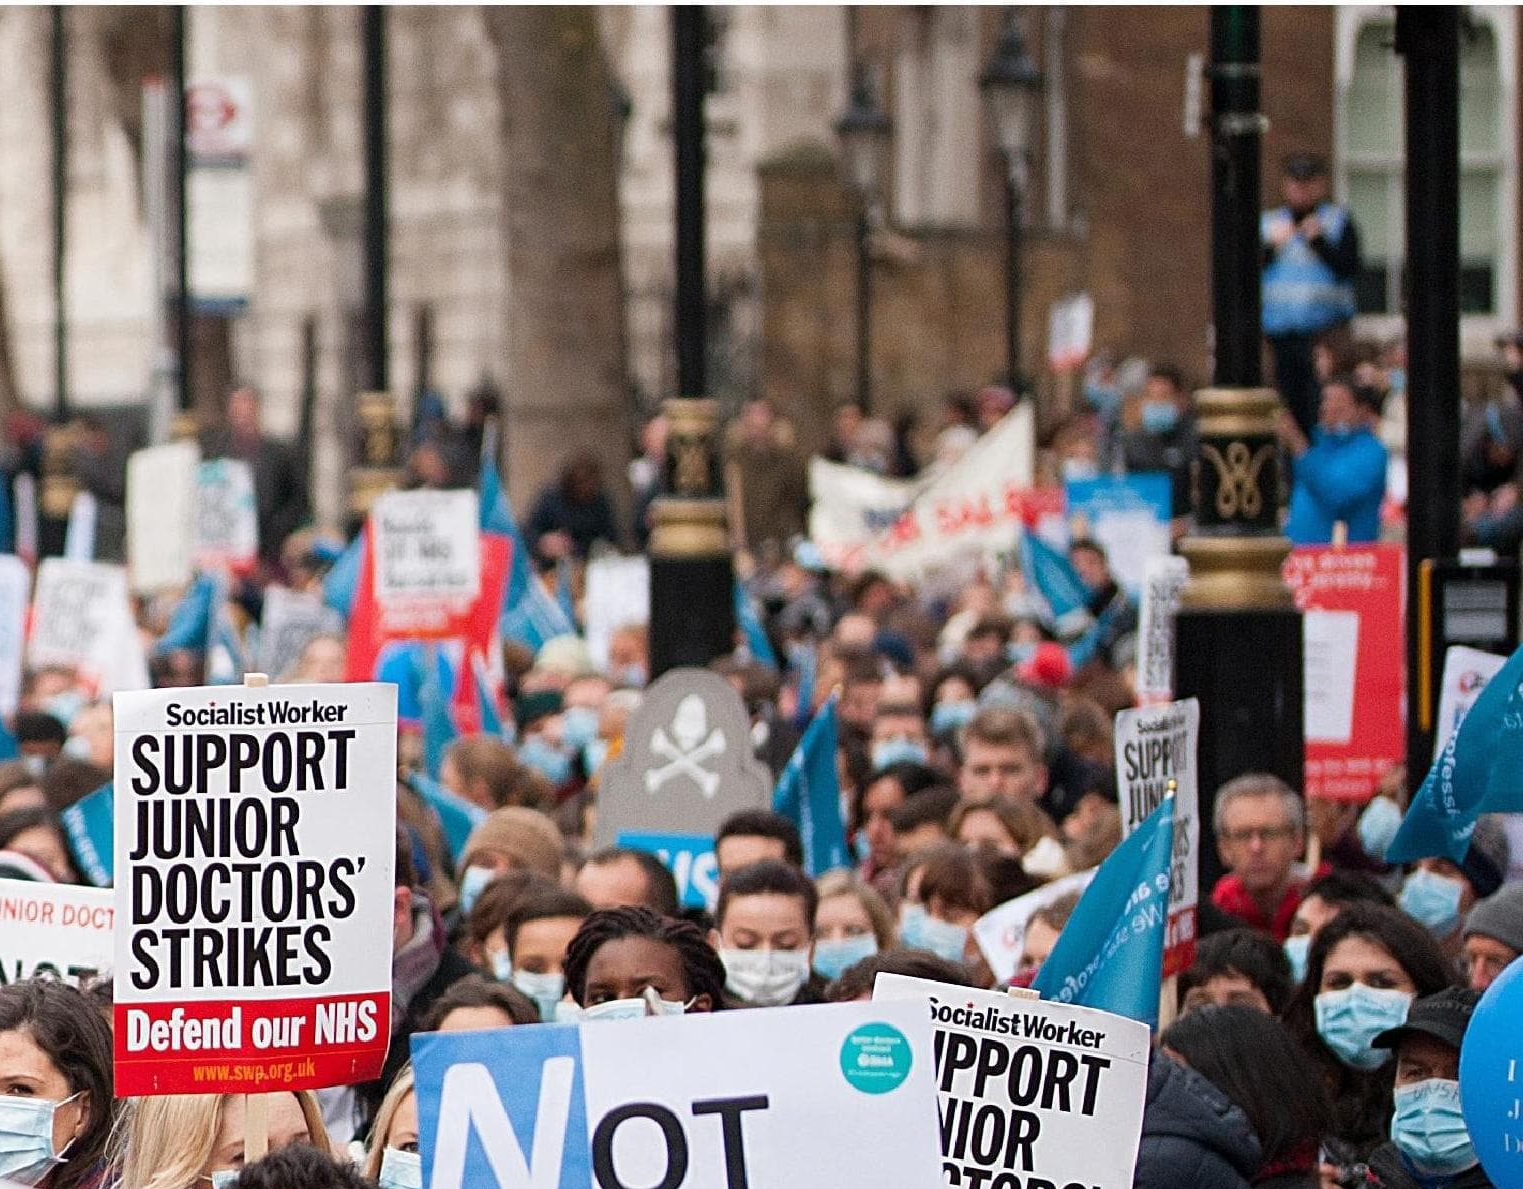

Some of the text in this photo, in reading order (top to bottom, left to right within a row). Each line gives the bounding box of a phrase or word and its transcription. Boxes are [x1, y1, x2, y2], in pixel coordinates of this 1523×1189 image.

[166, 700, 349, 727] Socialist Worker
[130, 729, 356, 797] SUPPORT
[129, 796, 300, 861] JUNIOR
[131, 856, 367, 926] DOCTORS'
[130, 924, 332, 991] STRIKES
[126, 999, 378, 1052] Defend our NHS
[1023, 1014, 1106, 1050] Worker
[192, 1058, 316, 1086] www.swp.org.uk
[934, 1029, 1111, 1117] PPORT
